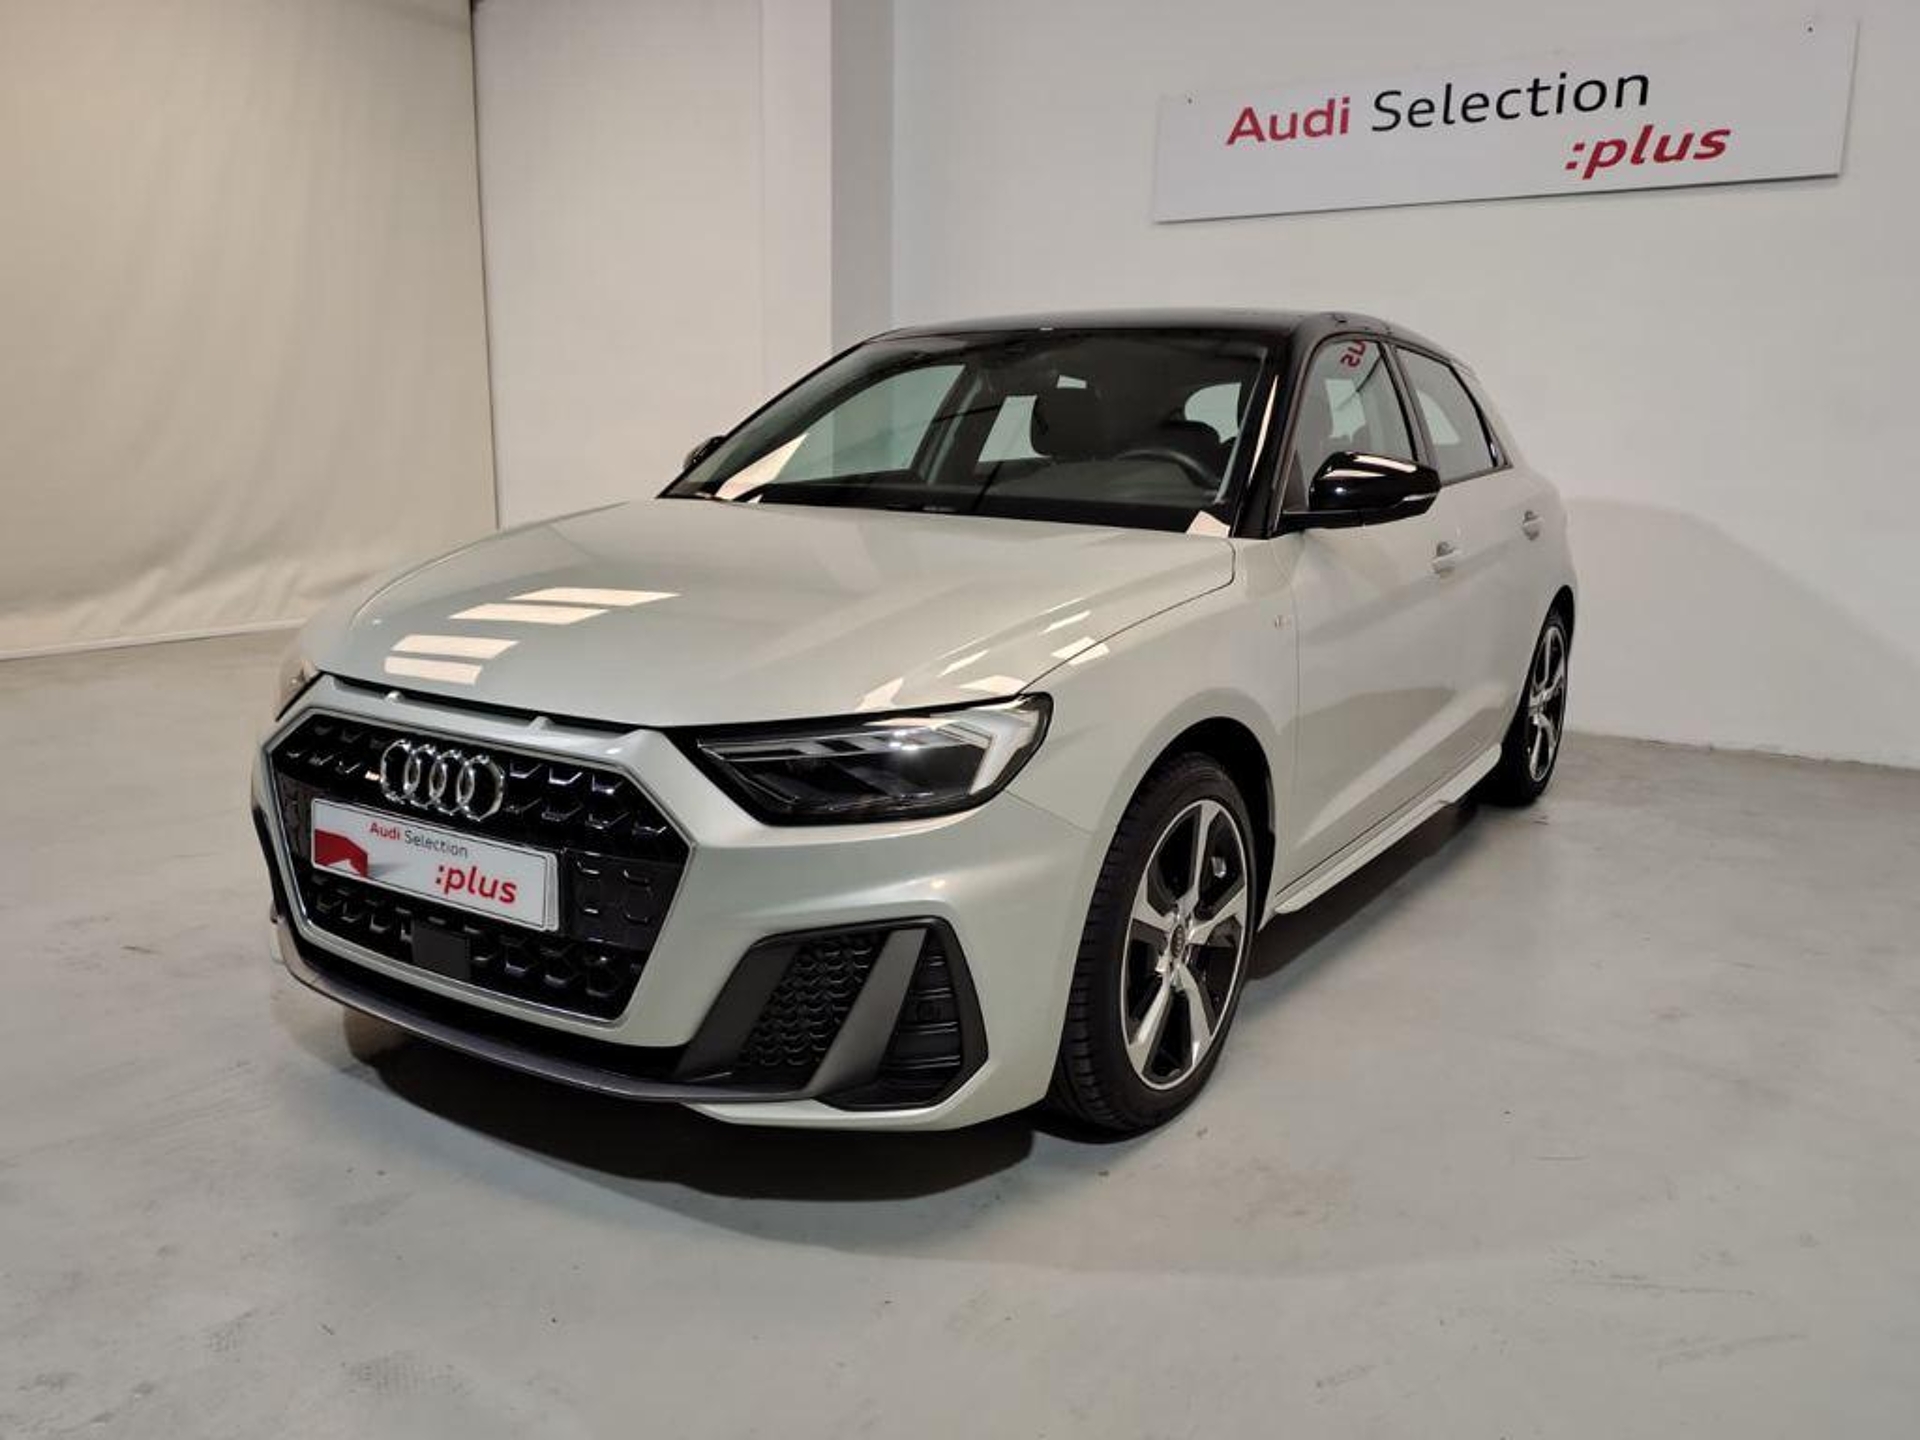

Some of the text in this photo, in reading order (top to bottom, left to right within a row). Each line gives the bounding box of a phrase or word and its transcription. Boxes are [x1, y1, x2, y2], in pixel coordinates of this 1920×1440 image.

[1226, 71, 1651, 146] Audi Selection
[1565, 125, 1732, 180] :plus
[369, 822, 469, 859] Audi Selection
[435, 864, 518, 905] :plus
